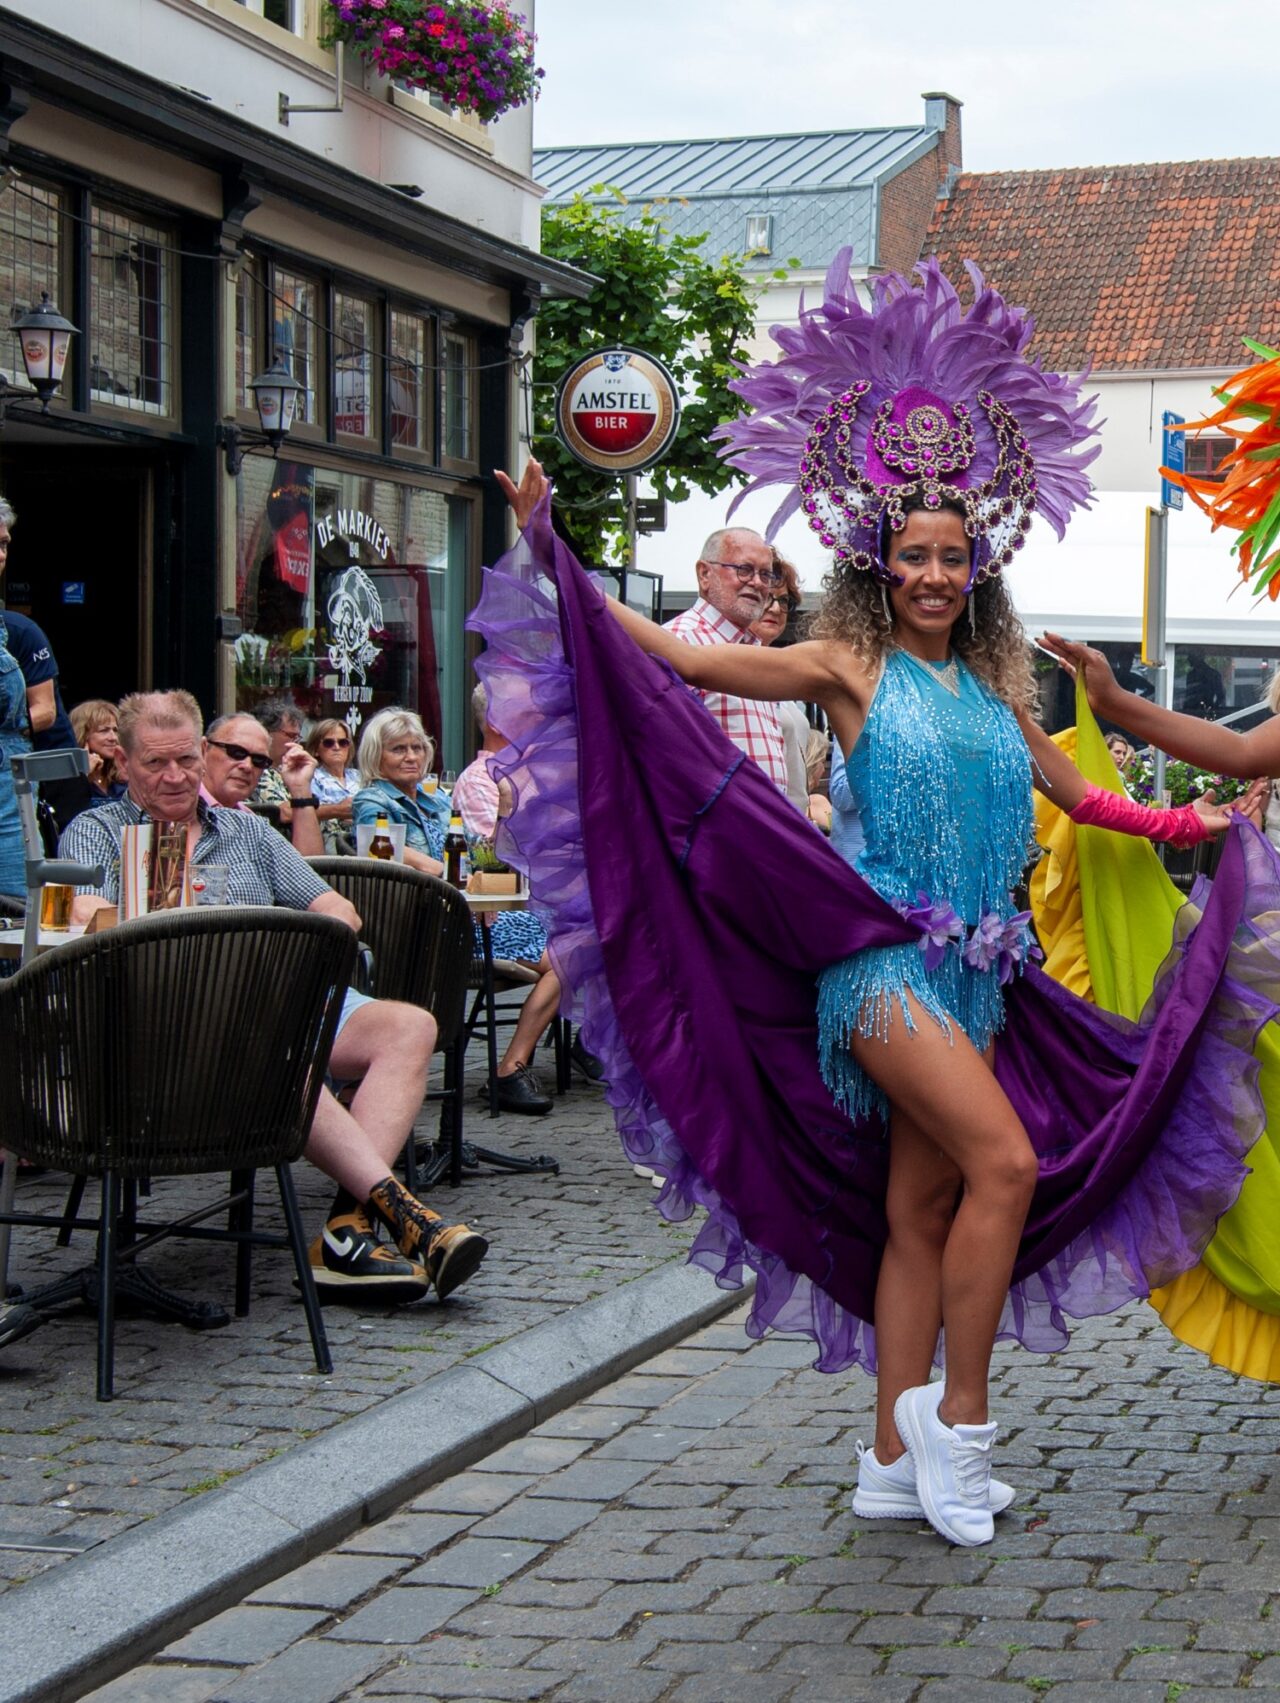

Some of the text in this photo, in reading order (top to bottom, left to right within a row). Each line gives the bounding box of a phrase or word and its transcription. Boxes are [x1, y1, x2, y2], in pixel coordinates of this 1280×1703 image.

[577, 392, 651, 410] AMSTEL
[595, 416, 628, 429] BIER
[317, 509, 390, 560] DE MARKIES
